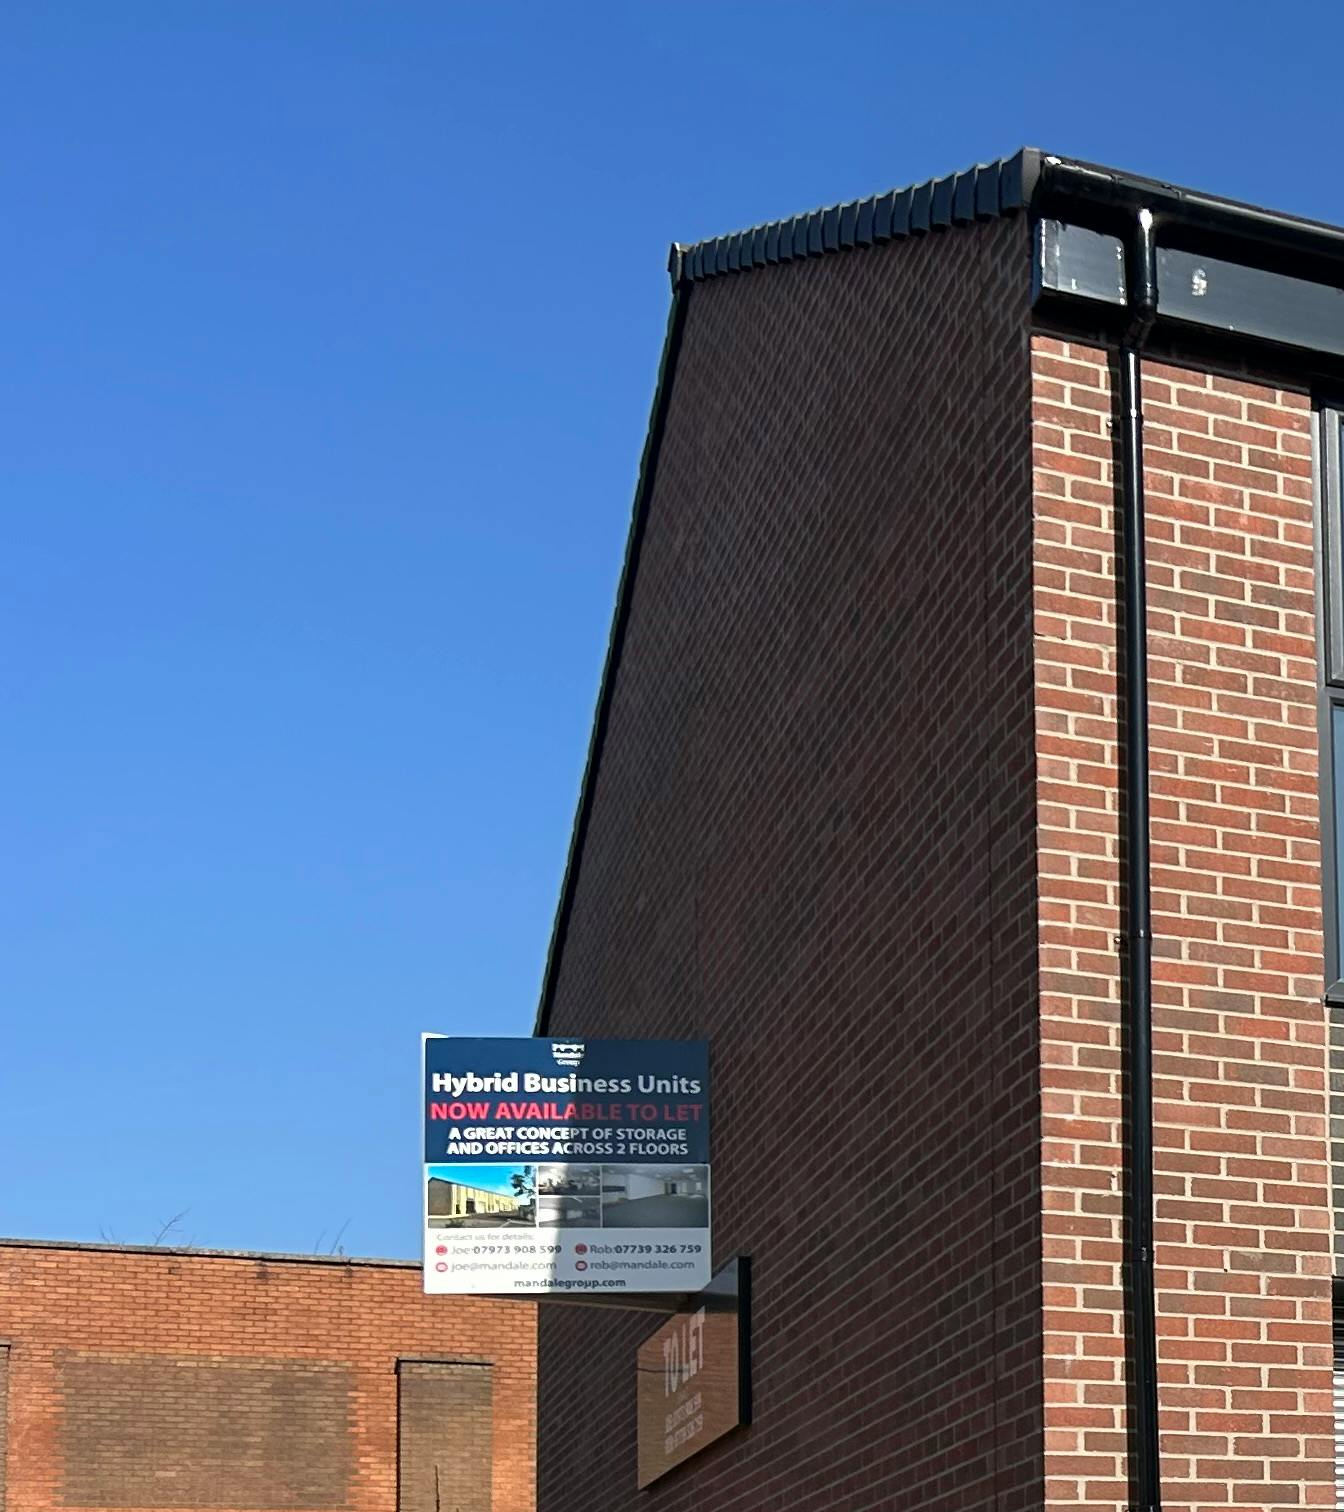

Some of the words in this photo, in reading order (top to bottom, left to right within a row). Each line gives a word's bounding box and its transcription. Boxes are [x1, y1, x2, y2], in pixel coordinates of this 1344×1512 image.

[432, 1072, 518, 1097] Hybrid
[524, 1073, 632, 1093] Business
[638, 1075, 701, 1094] Units
[430, 1102, 490, 1120] NOW
[495, 1102, 622, 1120] AVAILABLE
[627, 1103, 658, 1120] TO
[664, 1103, 703, 1121] LET
[448, 1127, 461, 1140] A
[463, 1127, 515, 1140] GREAT
[516, 1127, 589, 1140] CONCEPT
[592, 1128, 613, 1140] OF
[616, 1128, 687, 1141] STORAGE
[447, 1142, 483, 1154] AND
[485, 1141, 550, 1155] OFFICES
[552, 1142, 614, 1155] ACROSS
[616, 1143, 626, 1155] 2
[629, 1143, 689, 1155] FLOORS
[473, 1245, 511, 1254] 07973
[514, 1245, 536, 1254] 908
[540, 1245, 562, 1254] 599
[614, 1244, 652, 1254] 07739
[655, 1244, 677, 1254] 326
[680, 1244, 702, 1254] 759
[590, 1260, 695, 1271] rob@mandale.com
[514, 1279, 626, 1289] mandalegroup.com
